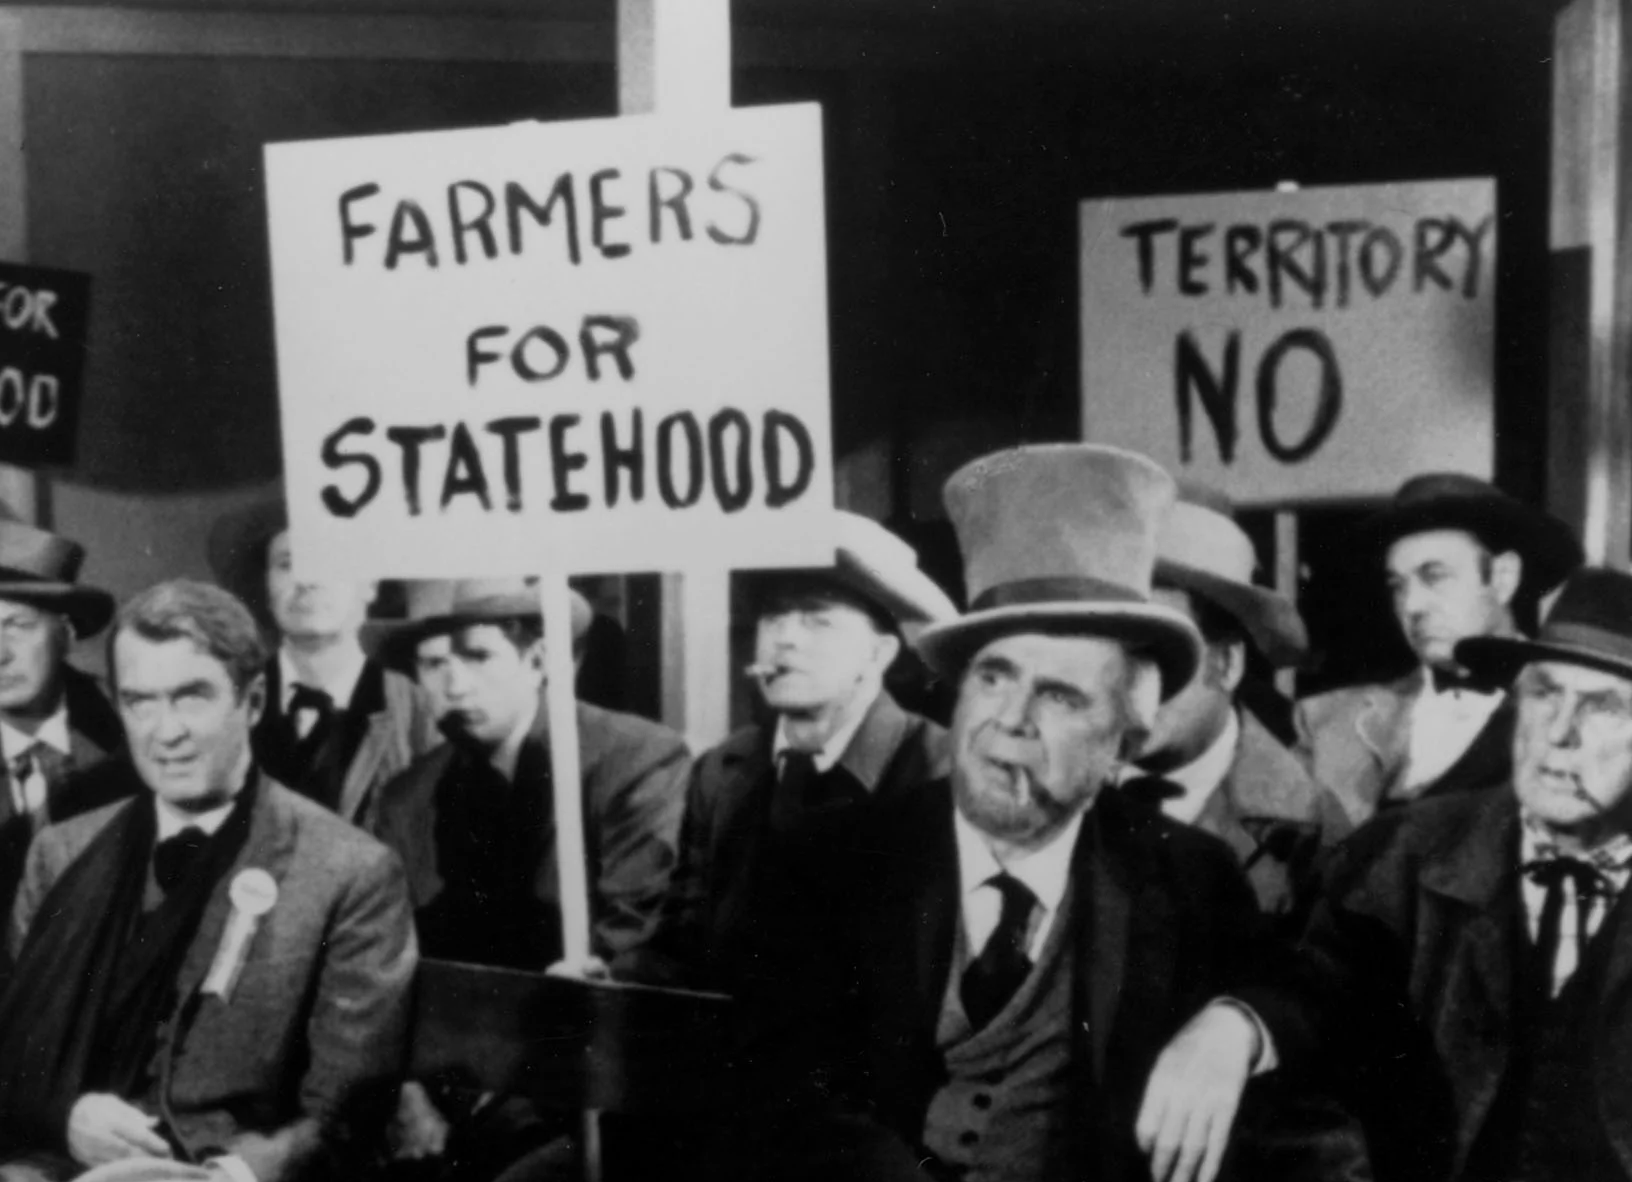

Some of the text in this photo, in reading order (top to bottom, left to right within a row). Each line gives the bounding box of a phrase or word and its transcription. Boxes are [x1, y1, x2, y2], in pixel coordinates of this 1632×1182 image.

[338, 153, 762, 269] FARMERS
[1119, 213, 1494, 309] TERRITORY
[467, 314, 640, 388] FOR
[1174, 327, 1343, 466] NO
[320, 406, 815, 519] STATEHOOD
